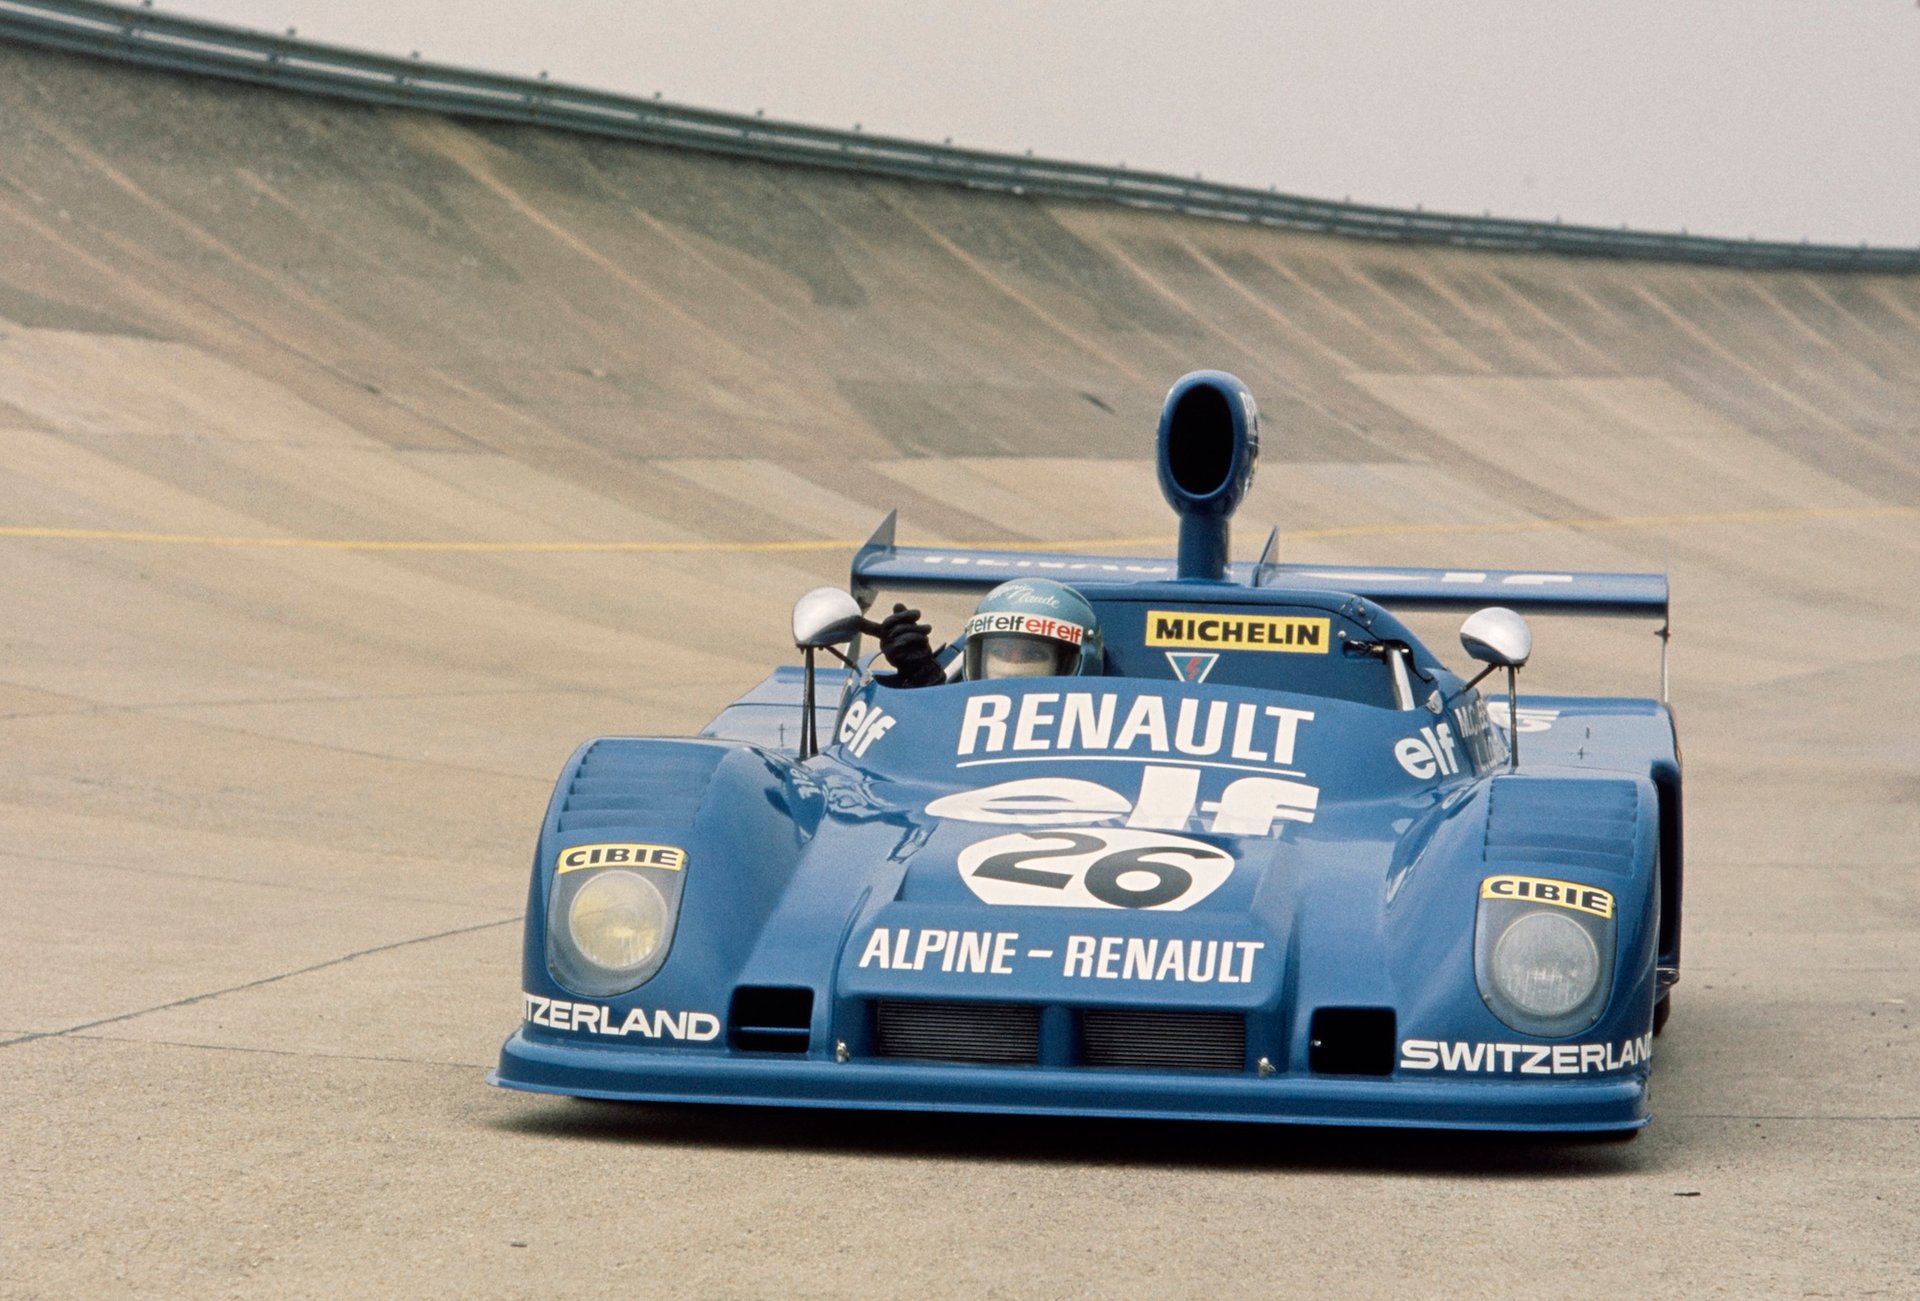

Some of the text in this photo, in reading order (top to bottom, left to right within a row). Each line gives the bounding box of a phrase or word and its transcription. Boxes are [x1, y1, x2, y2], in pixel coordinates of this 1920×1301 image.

[974, 616, 994, 632] elf
[995, 615, 1024, 631] elf
[1025, 619, 1056, 636] elf
[1056, 624, 1082, 643] elf
[1156, 618, 1320, 646] MICHELIN
[840, 700, 897, 759] elf
[957, 692, 1316, 765] RENAULT
[1394, 722, 1460, 780] elf
[924, 765, 1320, 836] elf
[971, 829, 1226, 910] 26
[859, 927, 1019, 975] ALPINE
[1062, 934, 1265, 983] RENAULT
